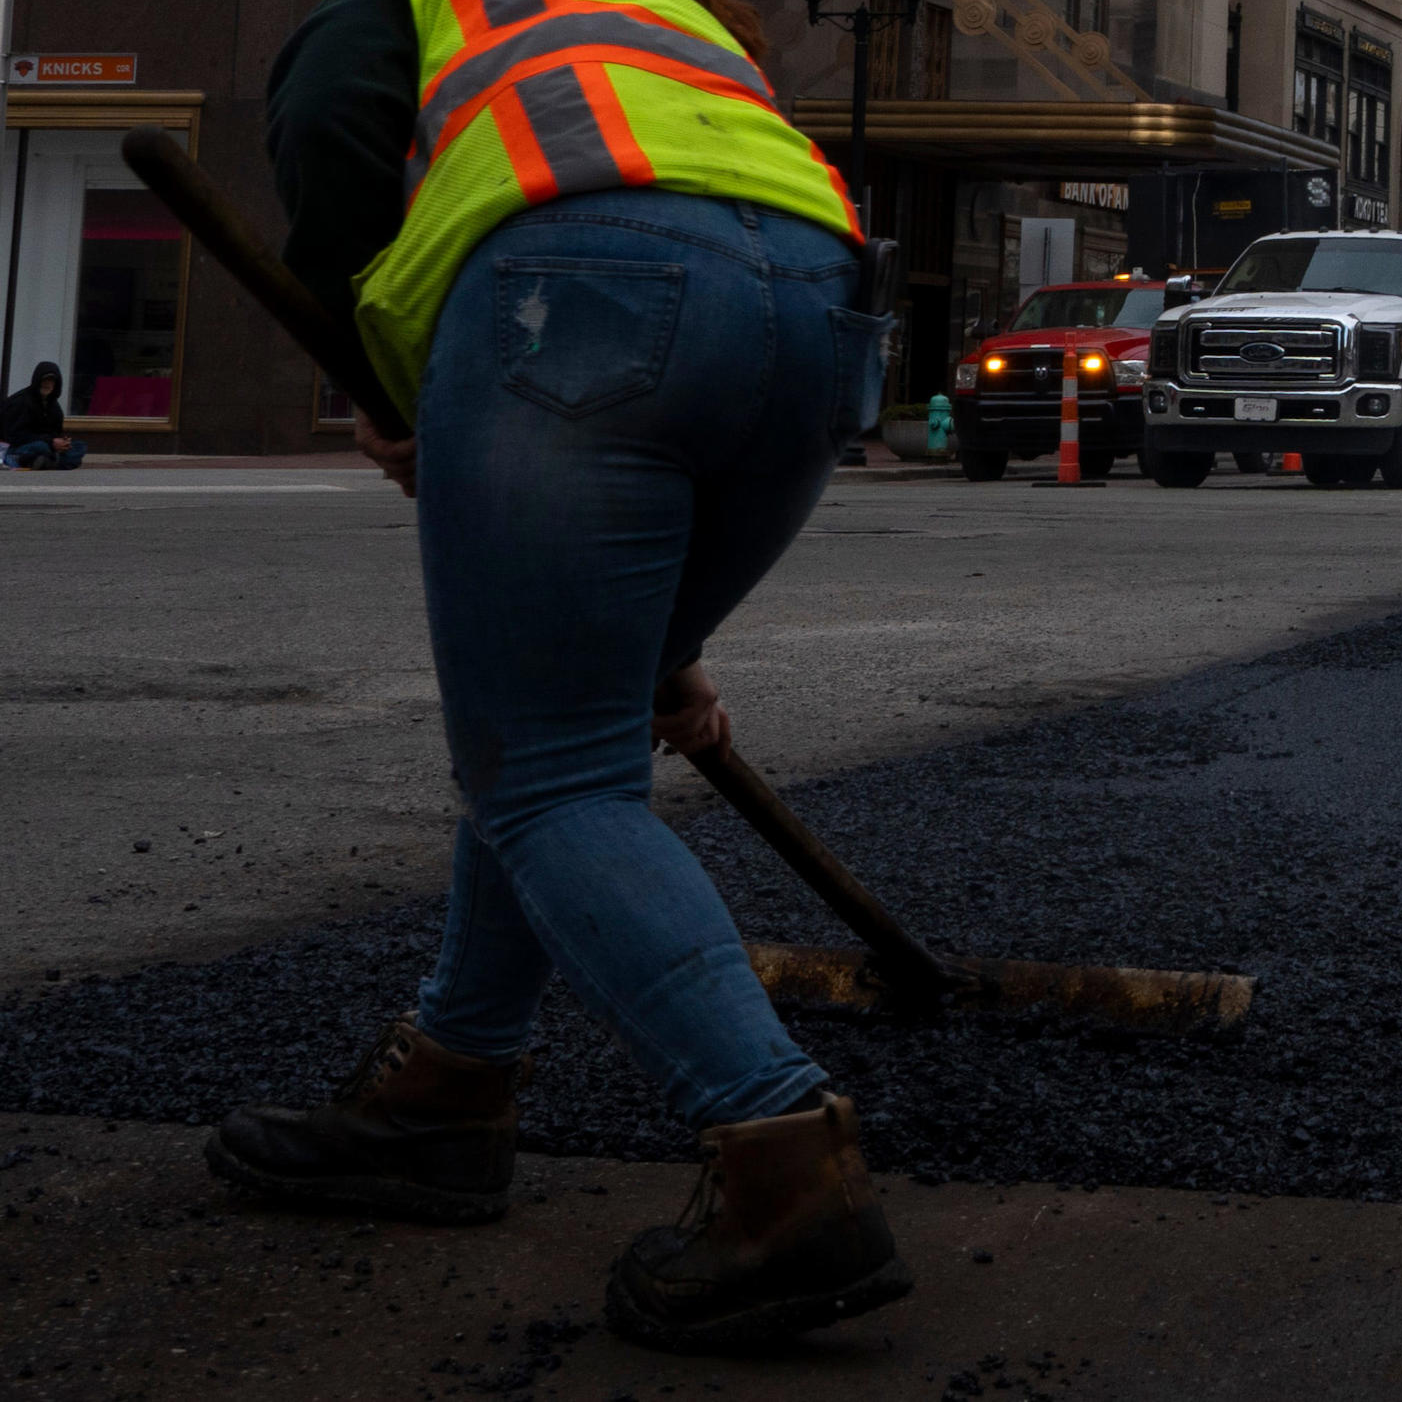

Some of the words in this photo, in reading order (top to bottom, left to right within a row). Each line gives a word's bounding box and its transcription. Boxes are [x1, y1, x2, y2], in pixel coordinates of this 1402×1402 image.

[42, 62, 103, 76] KNICKS
[1064, 182, 1095, 205] BANK
[1098, 183, 1113, 208] OF
